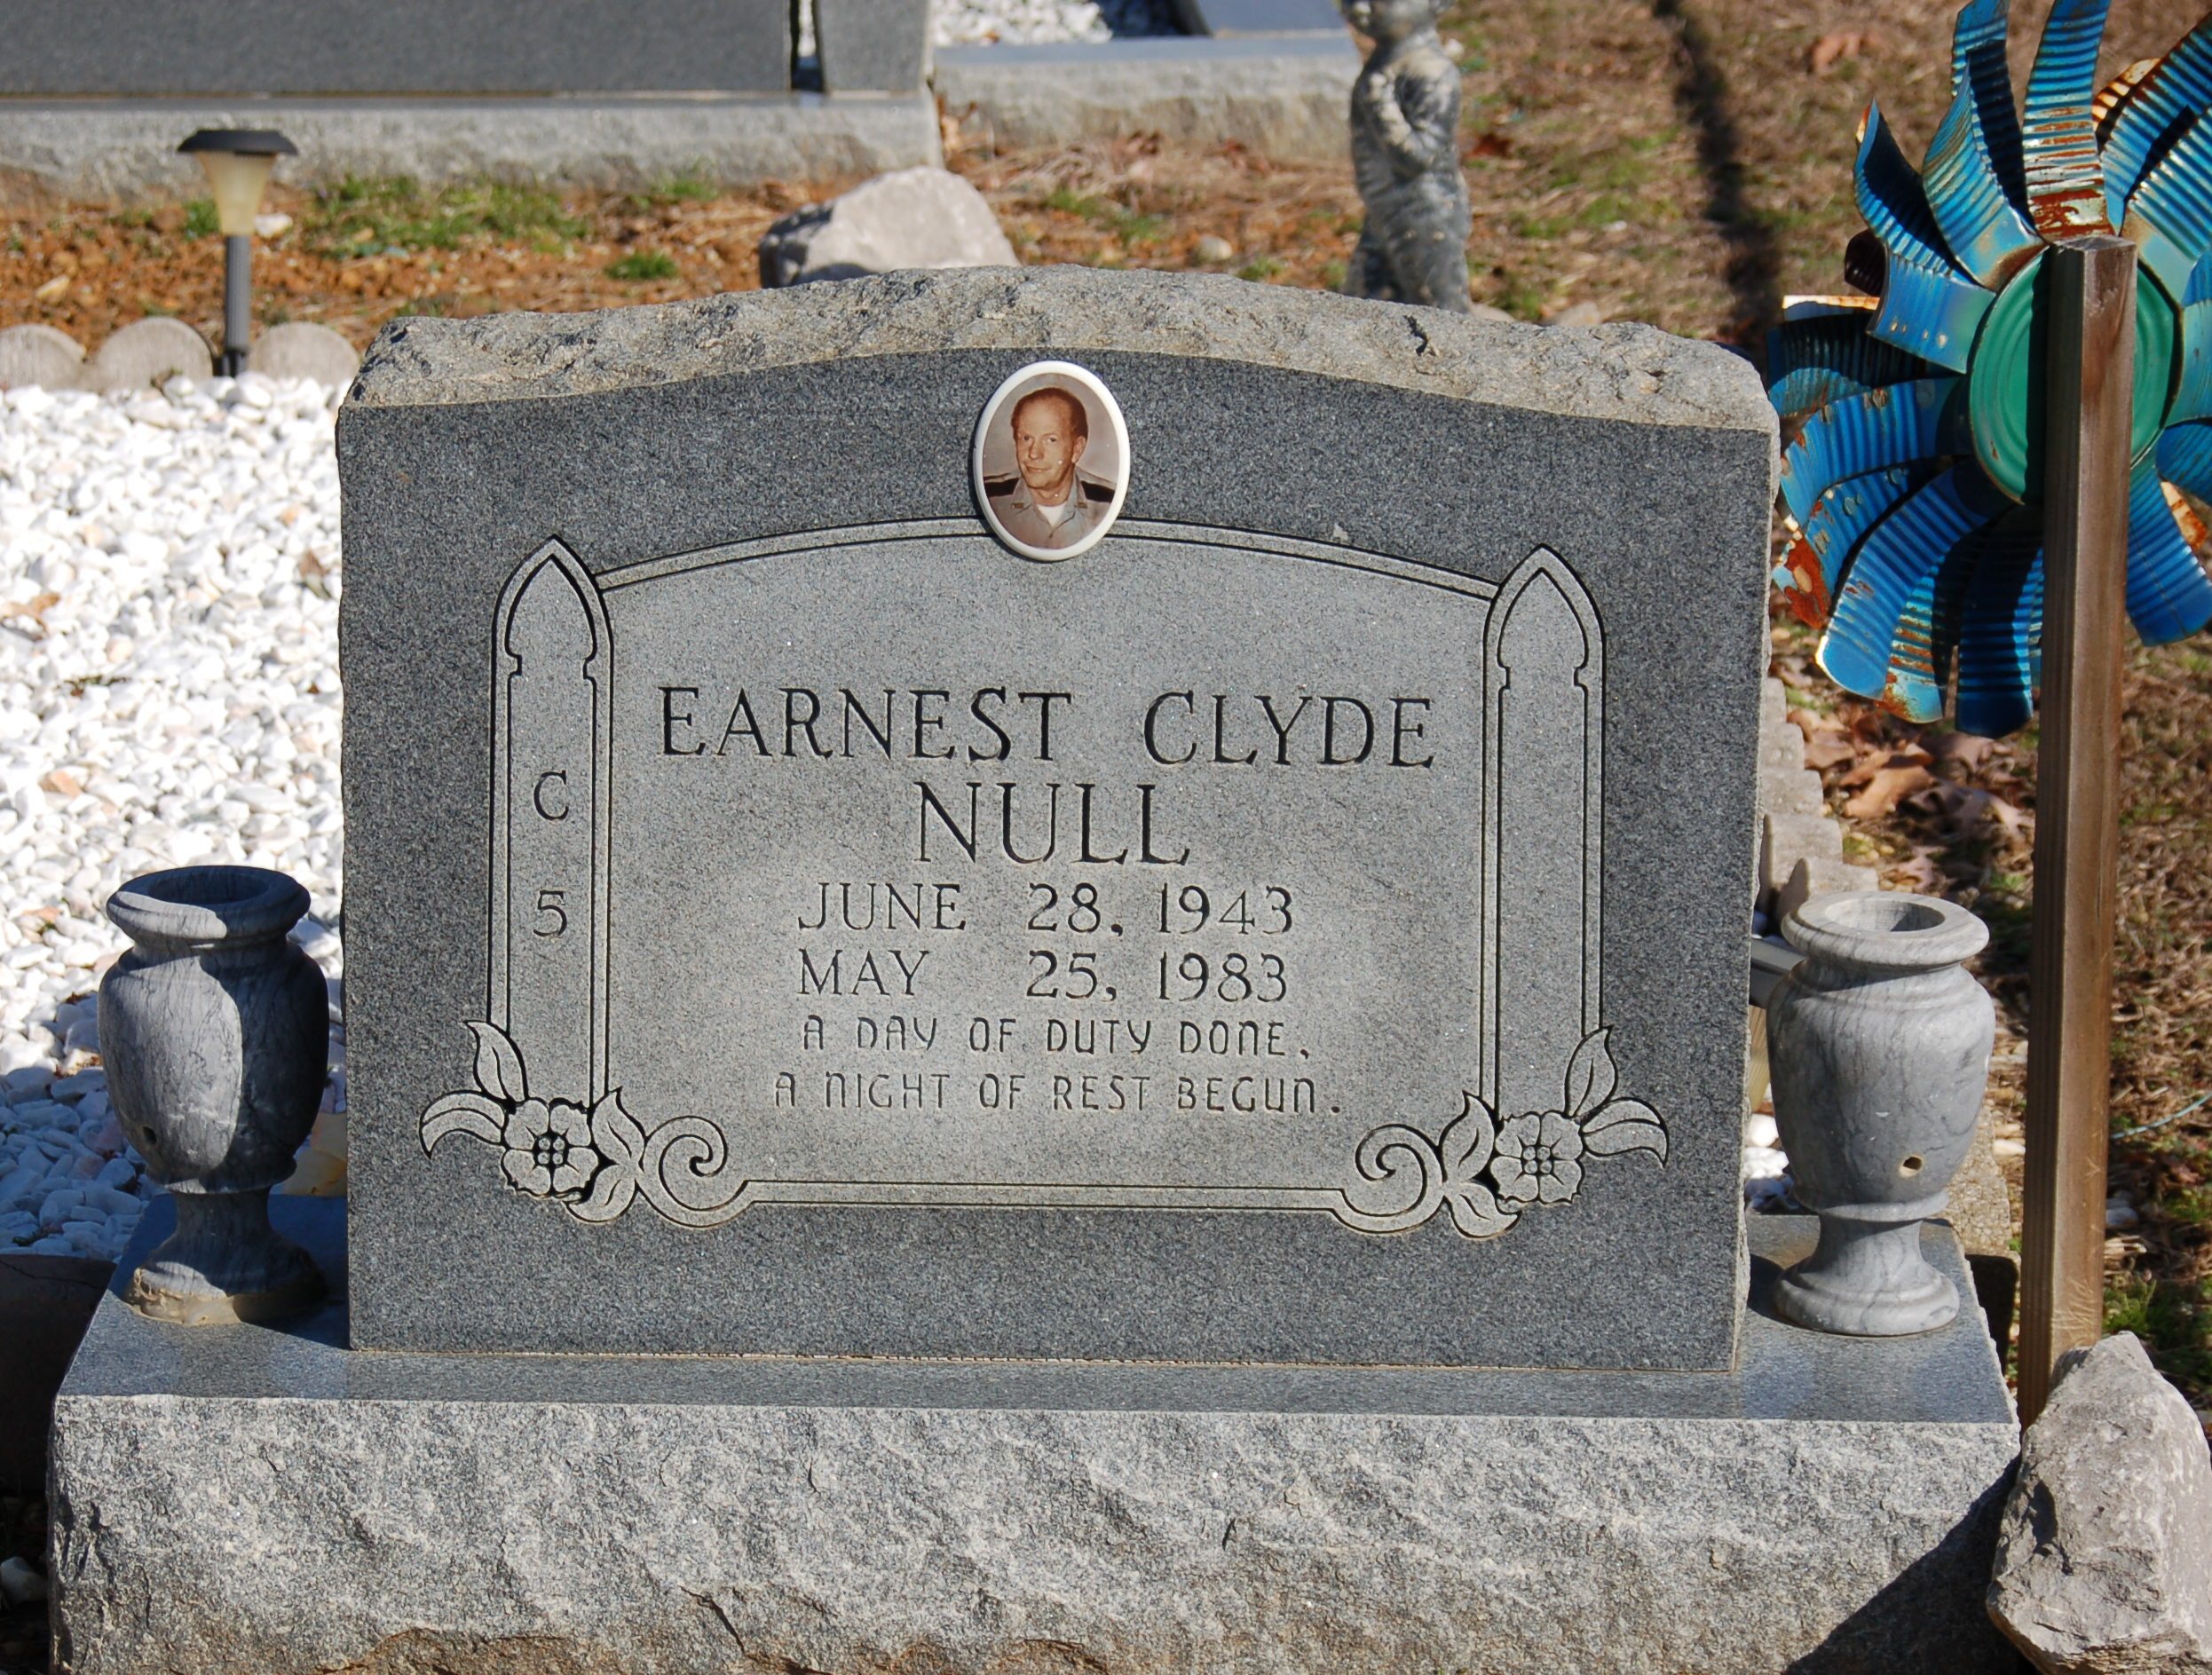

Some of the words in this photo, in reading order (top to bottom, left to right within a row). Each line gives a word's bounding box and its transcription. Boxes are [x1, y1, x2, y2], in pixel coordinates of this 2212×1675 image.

[658, 685, 1073, 762] EARNEST
[1143, 691, 1434, 770] CLYDE
[533, 770, 569, 820] C
[913, 780, 1190, 865] NULL
[533, 890, 567, 937] 5
[797, 882, 967, 931] JUNE
[1026, 881, 1124, 936] 28,
[1158, 881, 1294, 936] 1943
[798, 948, 930, 997] MAY
[1025, 950, 1118, 1002] 25,
[1158, 951, 1289, 1002] 1983
[802, 1015, 825, 1050] A
[856, 1015, 938, 1051] DAY
[968, 1018, 1017, 1053] OF
[1047, 1018, 1151, 1055] DUTY
[775, 1071, 797, 1107] A
[978, 1073, 1023, 1110] OF
[1053, 1075, 1150, 1111] REST
